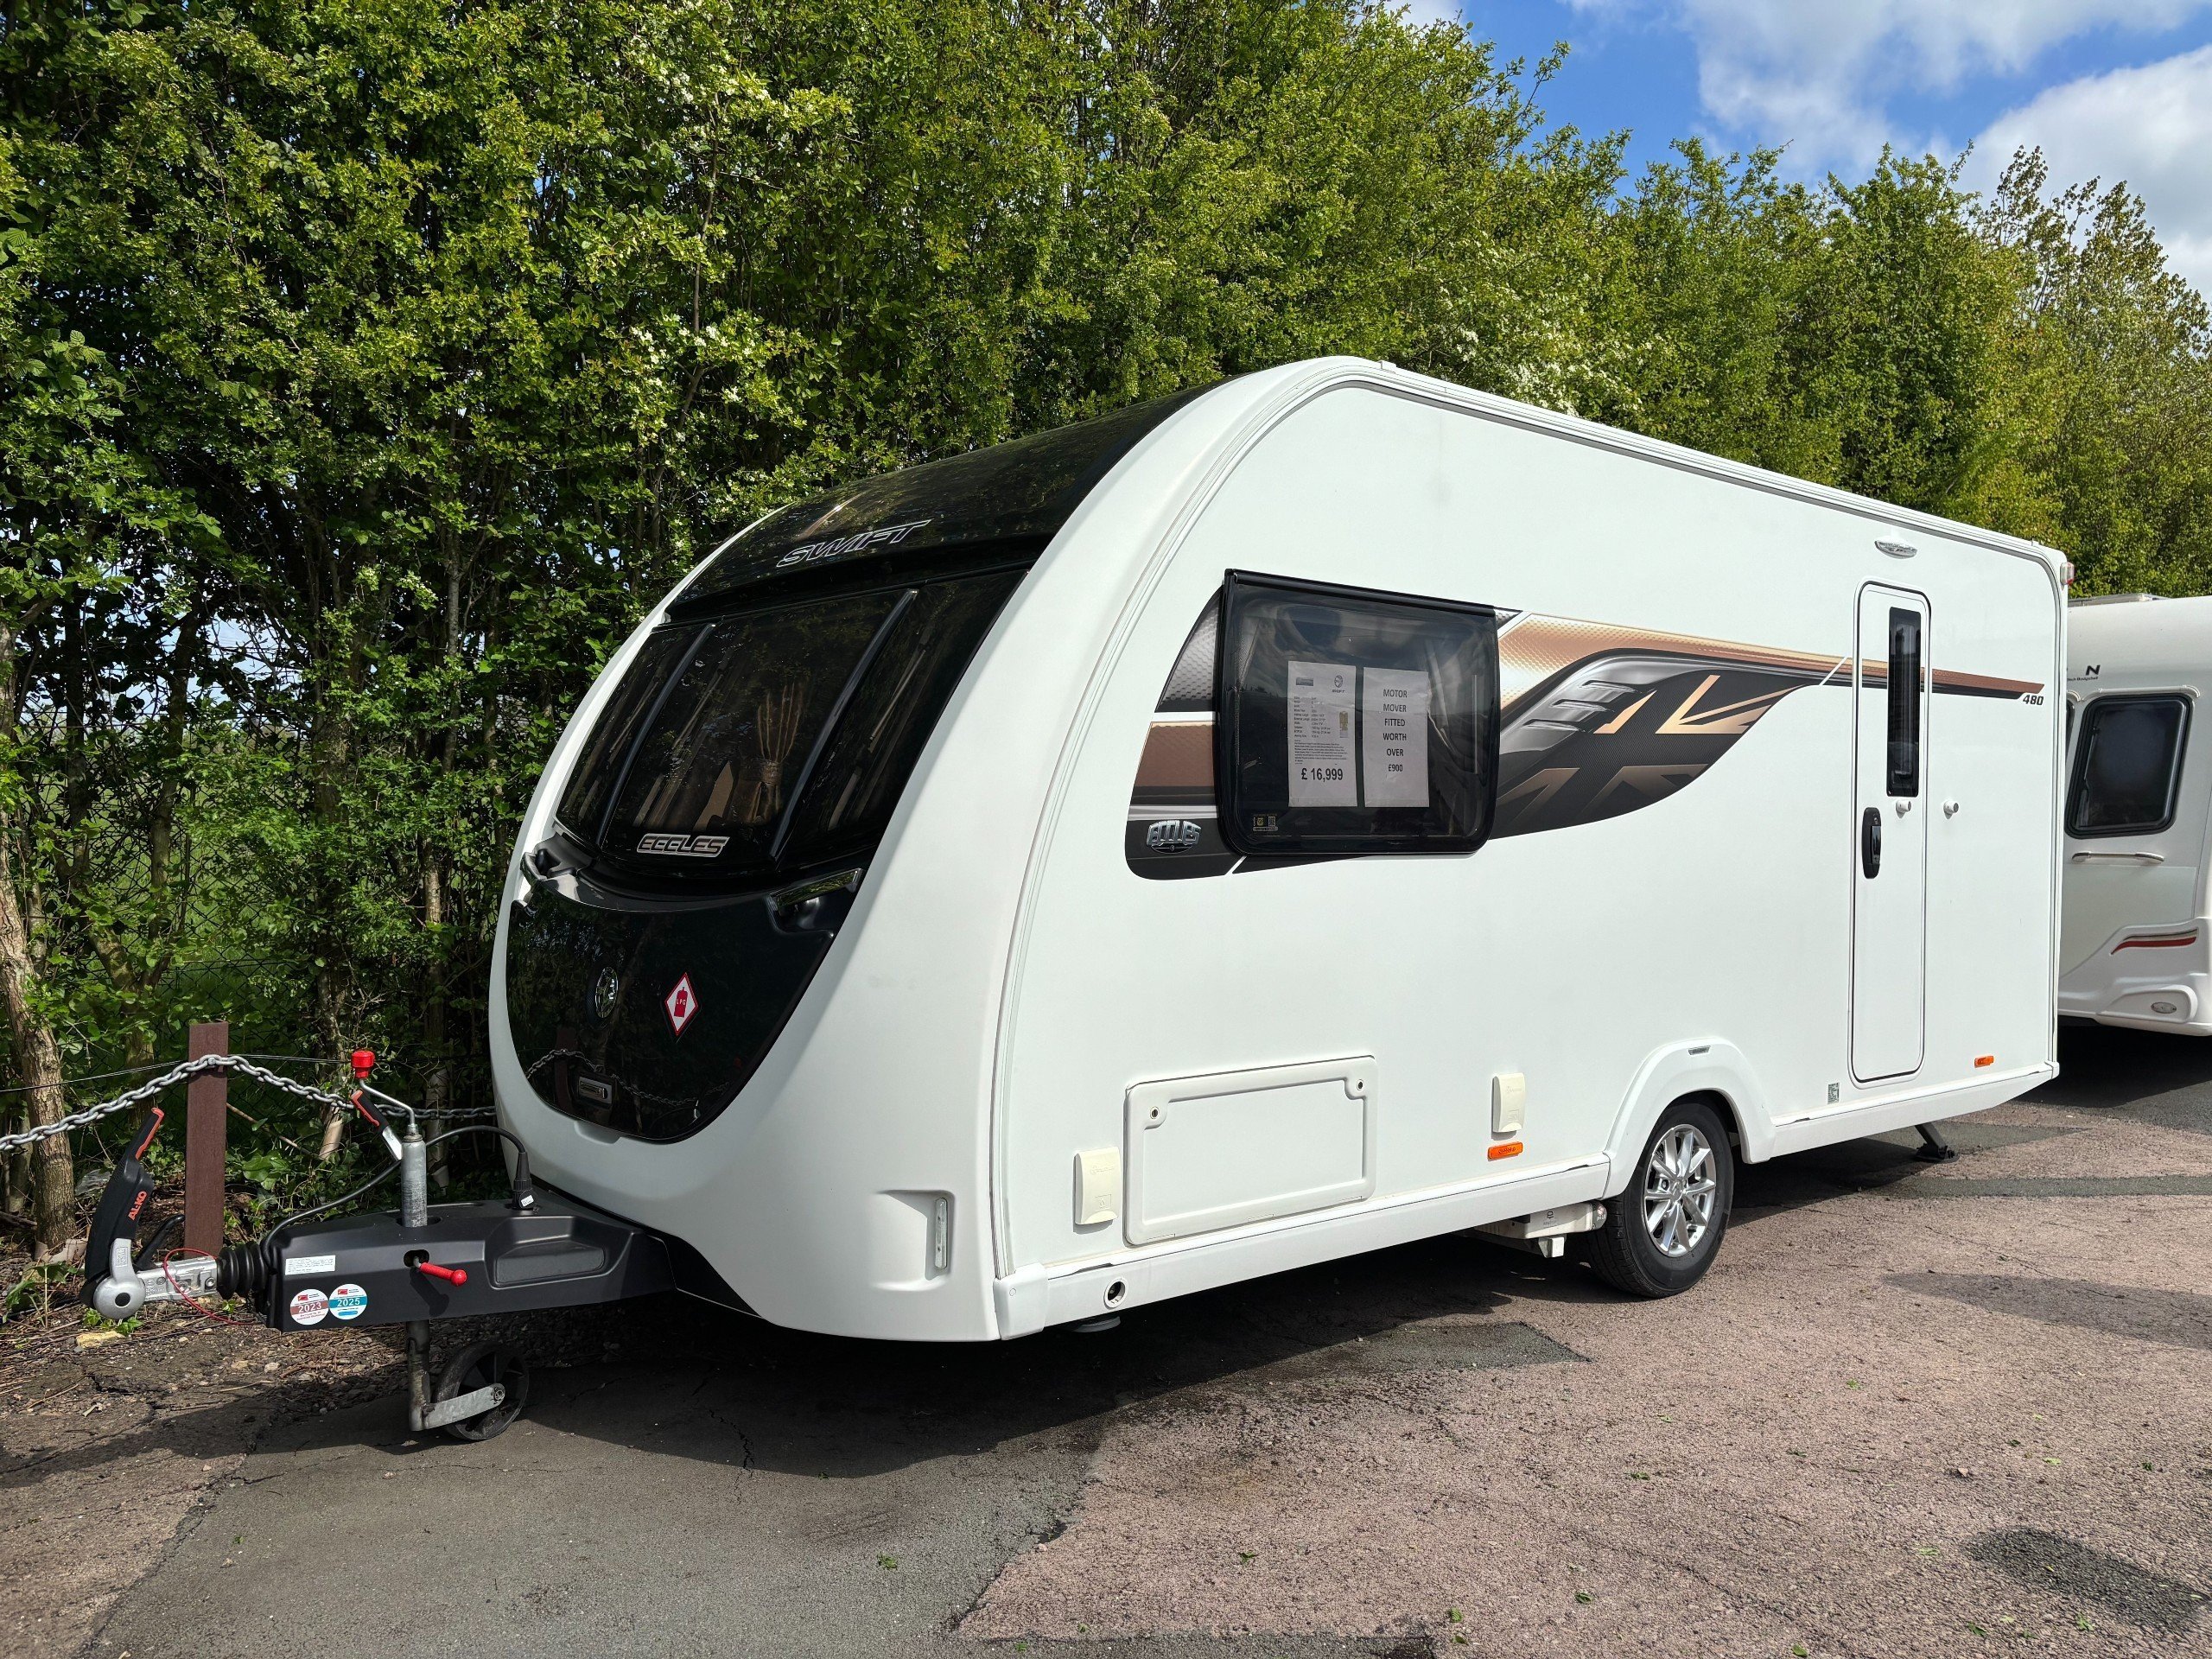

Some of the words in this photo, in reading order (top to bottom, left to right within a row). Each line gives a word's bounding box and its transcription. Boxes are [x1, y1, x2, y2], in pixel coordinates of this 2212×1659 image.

[776, 518, 934, 568] SWIFT
[1382, 689, 1408, 698] MOTOR
[2022, 694, 2044, 706] 480
[1382, 703, 1408, 713] MOVER
[1384, 718, 1406, 727] FITTED
[1382, 733, 1408, 741] WORTH
[1386, 748, 1404, 757] OVER
[1388, 764, 1403, 772] £900
[1300, 767, 1308, 780] £
[1311, 767, 1343, 783] 16,999
[637, 833, 730, 858] ECCLES
[128, 1191, 148, 1221] AL-KO
[336, 1297, 360, 1307] 2025
[298, 1302, 322, 1313] 2023
